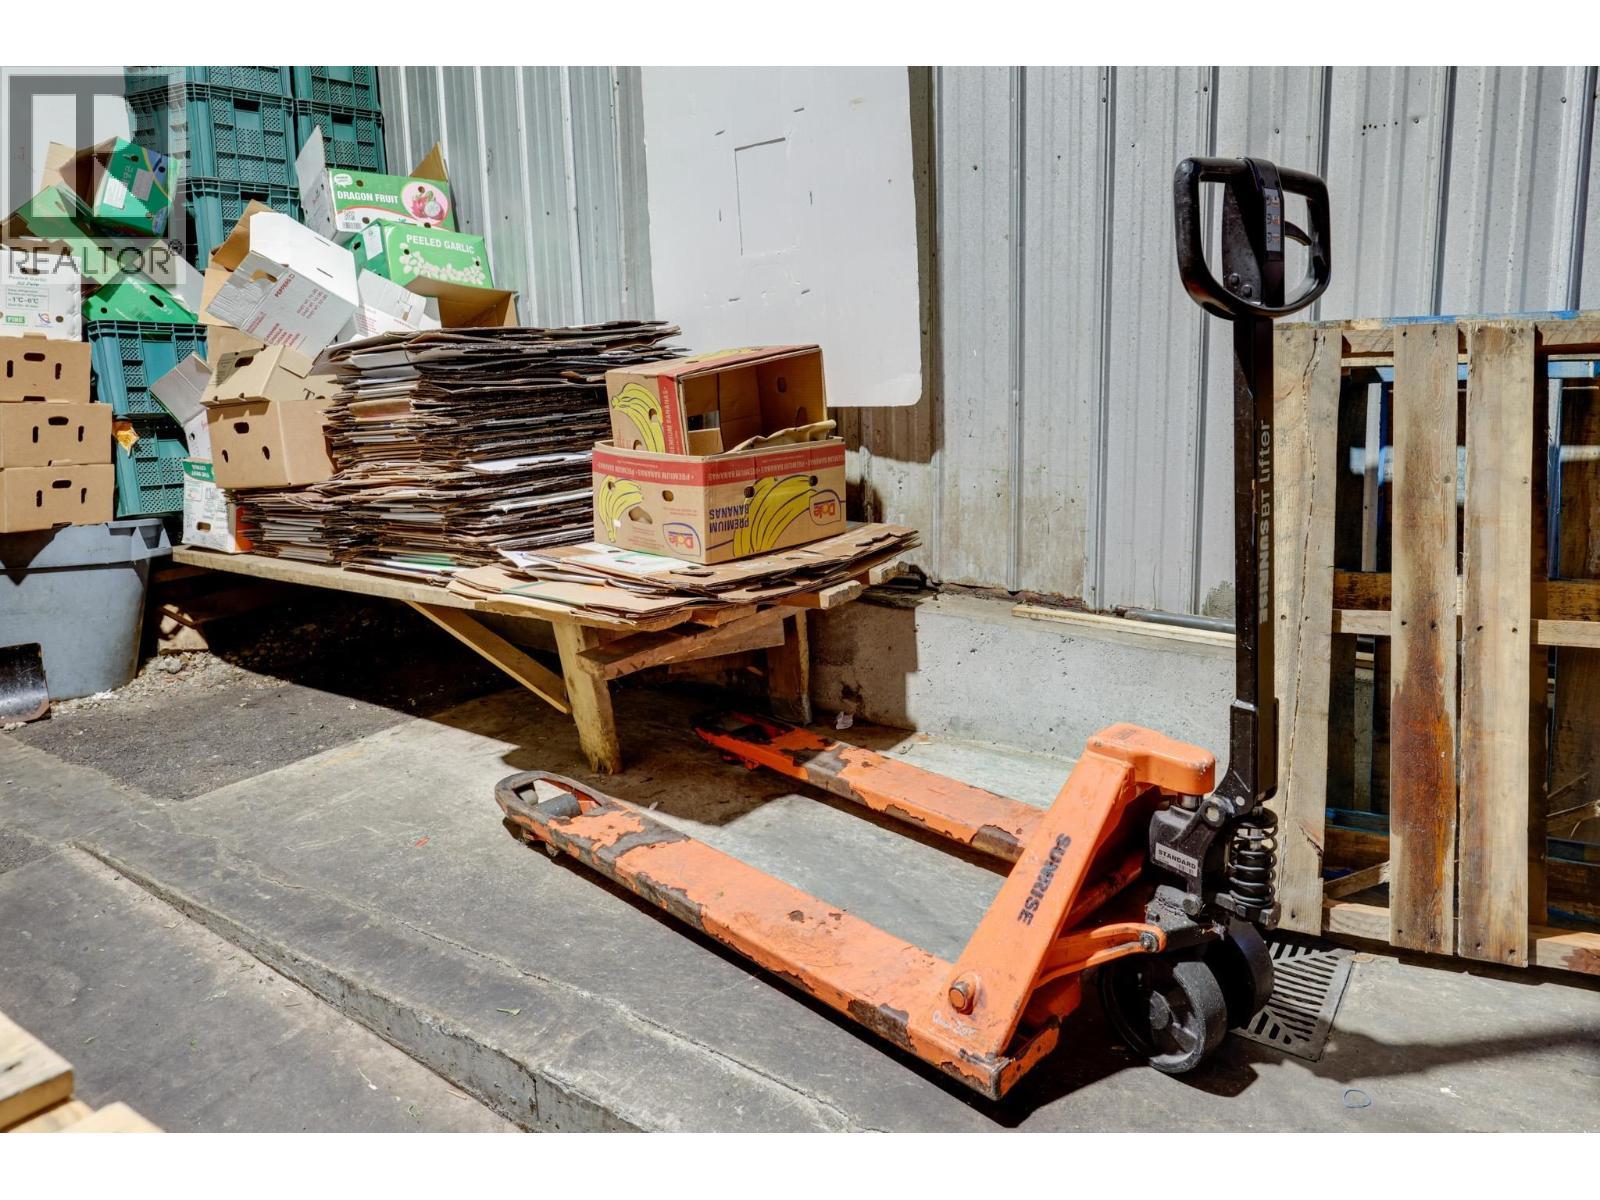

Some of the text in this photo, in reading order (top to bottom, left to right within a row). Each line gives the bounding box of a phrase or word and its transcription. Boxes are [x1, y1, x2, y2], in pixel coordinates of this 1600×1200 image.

[337, 190, 399, 204] DRAGON FRUIT
[405, 234, 475, 254] PEELED GARLIC
[274, 278, 292, 297] PEPPERS
[662, 388, 672, 425] BANANAS
[660, 471, 690, 481] PREMIUM
[1258, 420, 1270, 518] BT Lifter
[709, 503, 749, 520] BANANAS
[814, 502, 836, 518] Dole
[709, 517, 749, 533] PREMIUM
[667, 534, 694, 549] Dole
[1258, 519, 1270, 624] SUNRISE
[1158, 849, 1196, 870] STANDARD
[1017, 833, 1071, 926] SUNRISE
